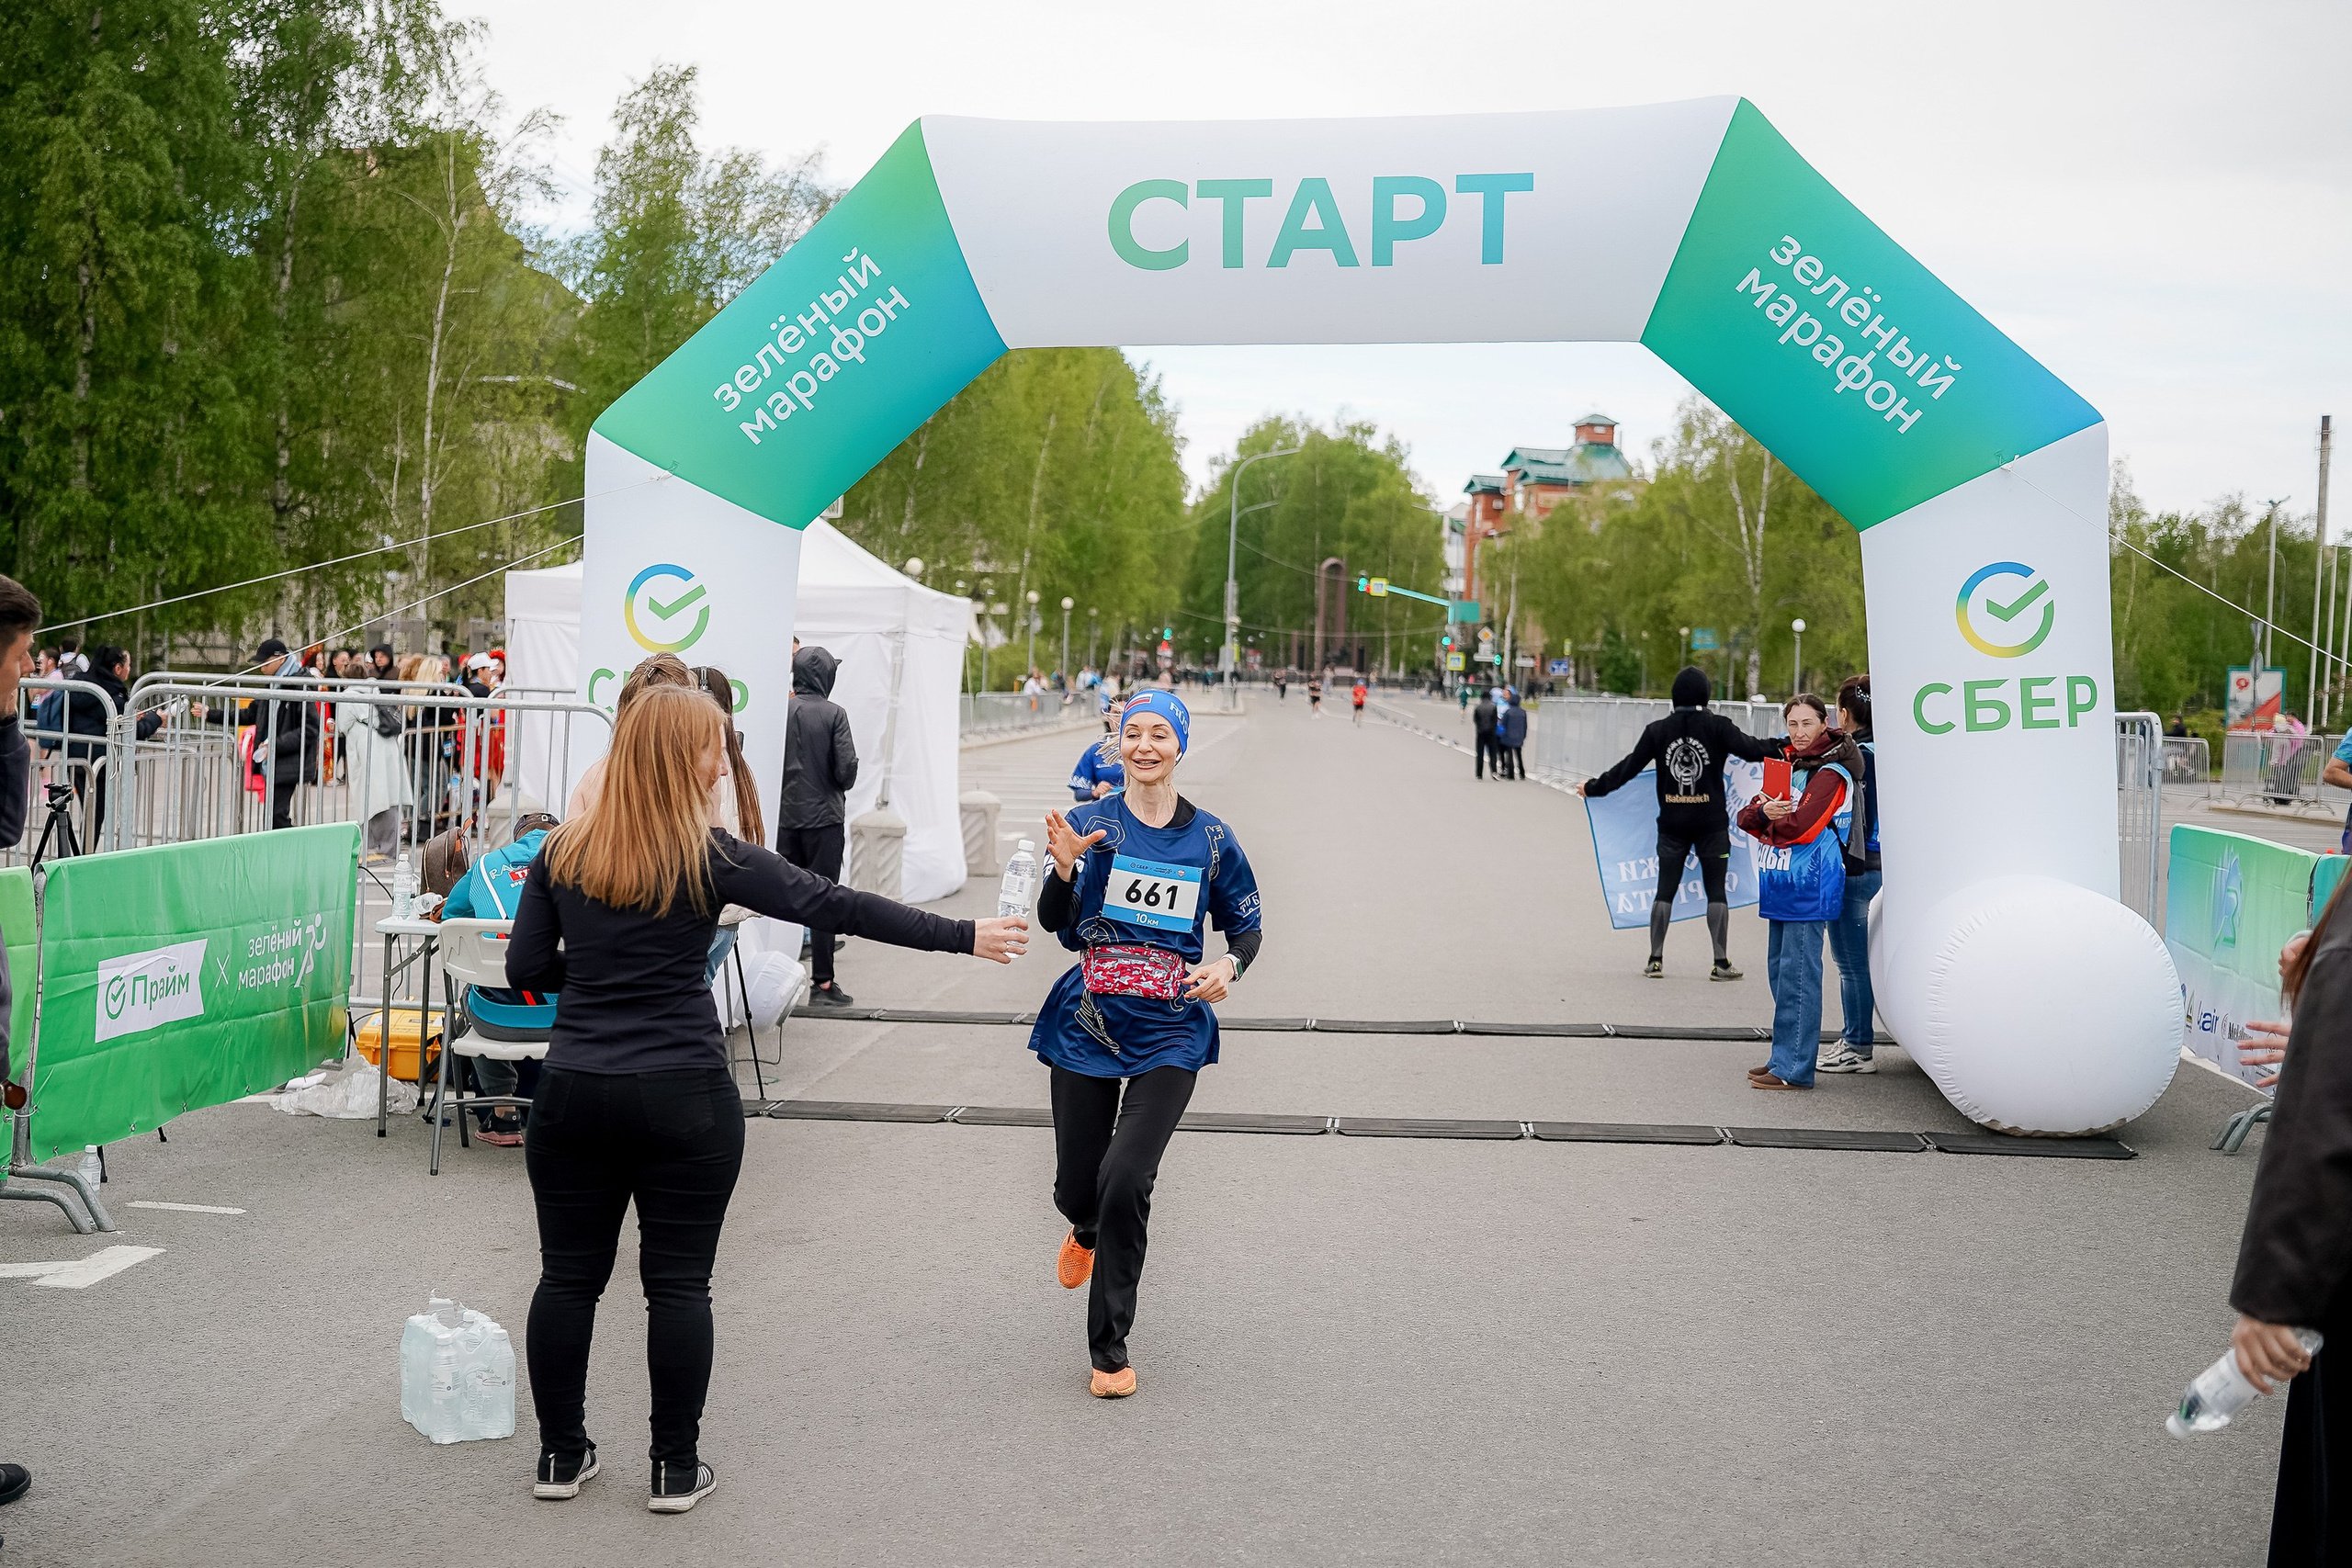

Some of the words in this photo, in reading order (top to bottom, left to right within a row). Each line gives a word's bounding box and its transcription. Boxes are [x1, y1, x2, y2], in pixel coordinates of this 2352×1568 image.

[1107, 173, 1534, 271] СТАРТ
[712, 246, 883, 412] зелёный
[1735, 266, 1924, 434] марафон
[1769, 234, 1963, 400] зелёный
[739, 285, 910, 446] марафон
[1913, 675, 2098, 735] СБЕР
[1125, 878, 1179, 910] 661
[238, 956, 295, 993] марафон
[247, 919, 302, 958] зелёный
[130, 964, 190, 1010] Прайм
